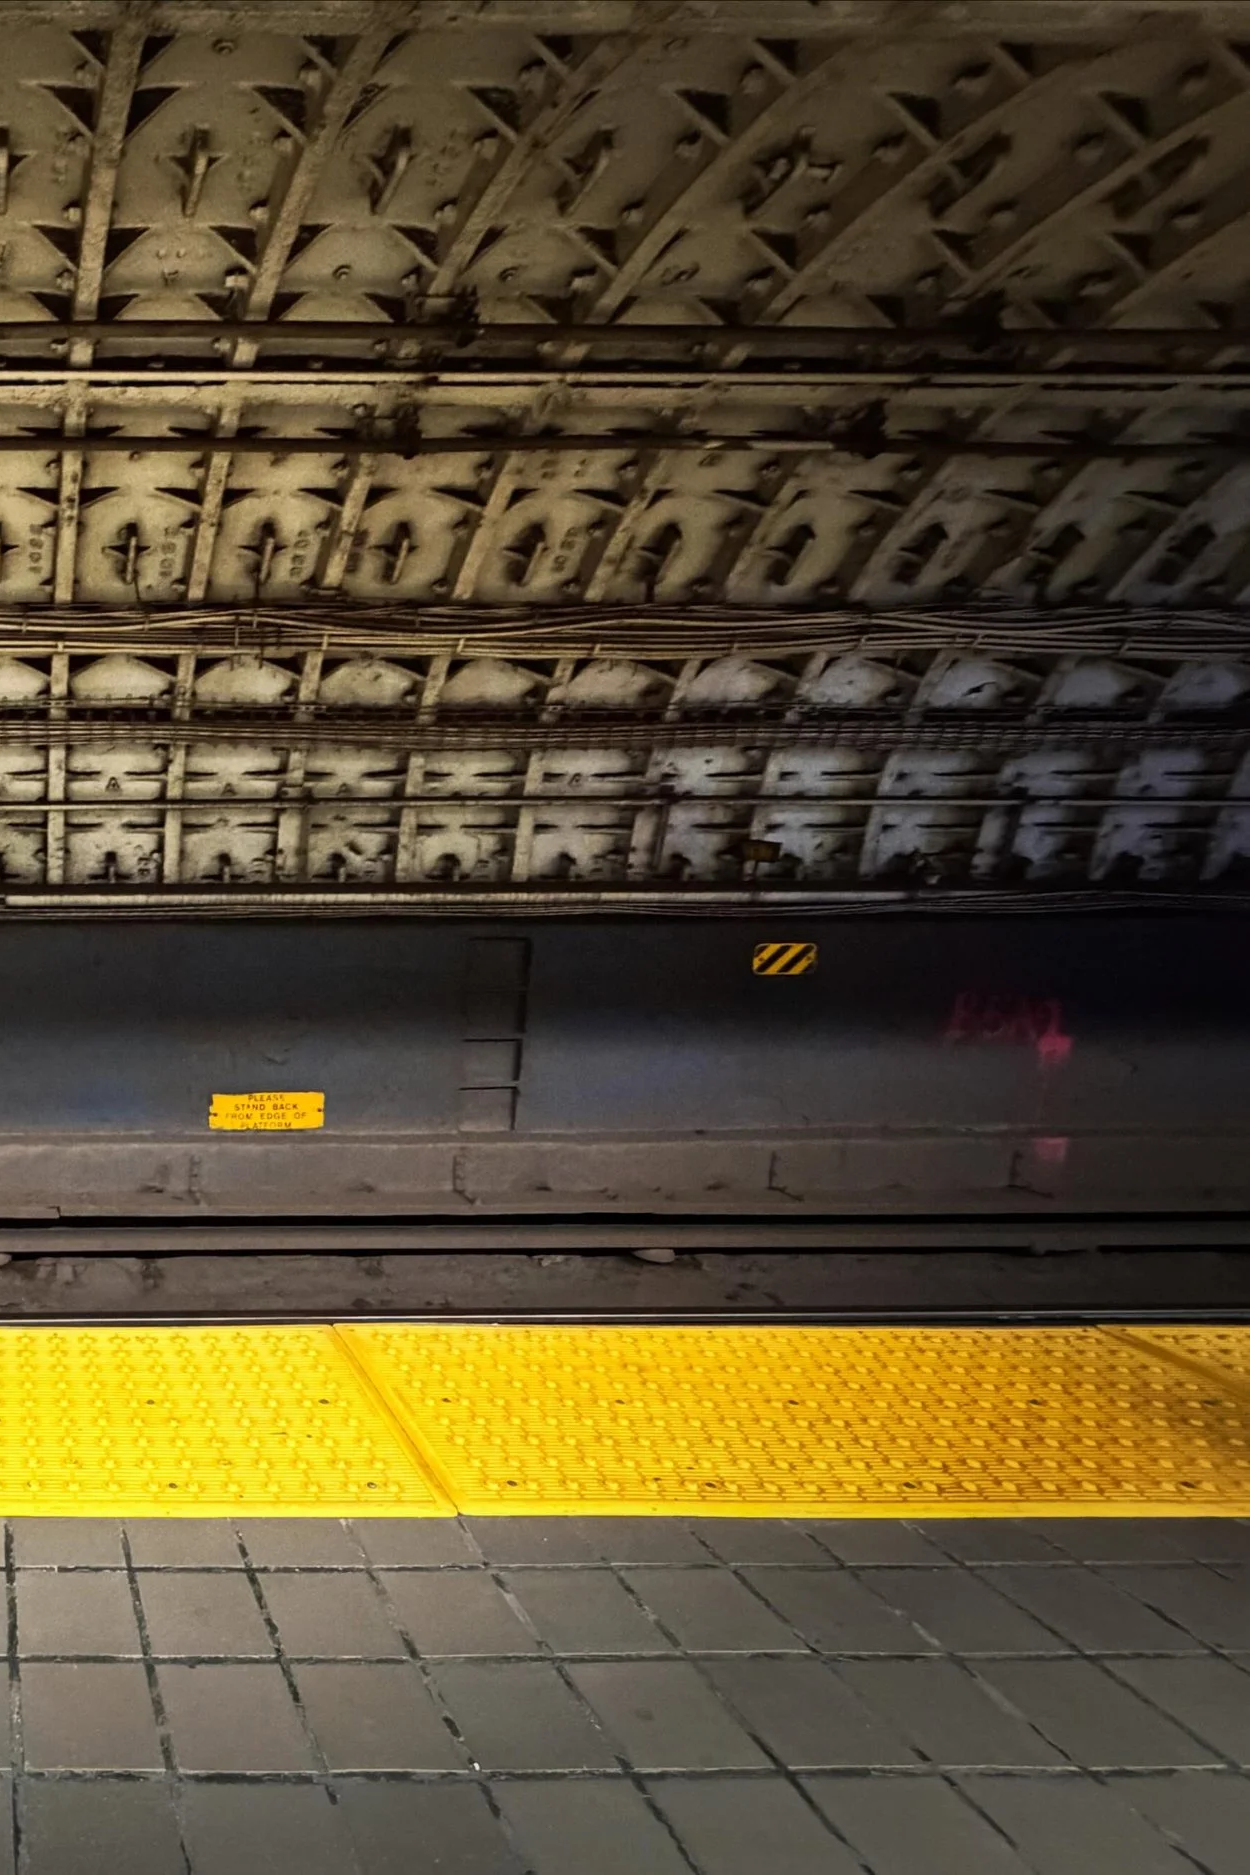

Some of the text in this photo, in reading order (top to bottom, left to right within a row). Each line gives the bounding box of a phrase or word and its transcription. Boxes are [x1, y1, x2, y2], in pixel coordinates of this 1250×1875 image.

[234, 1103, 298, 1111] STAND BACK
[260, 1112, 287, 1120] EDGE
[293, 1112, 307, 1120] OF
